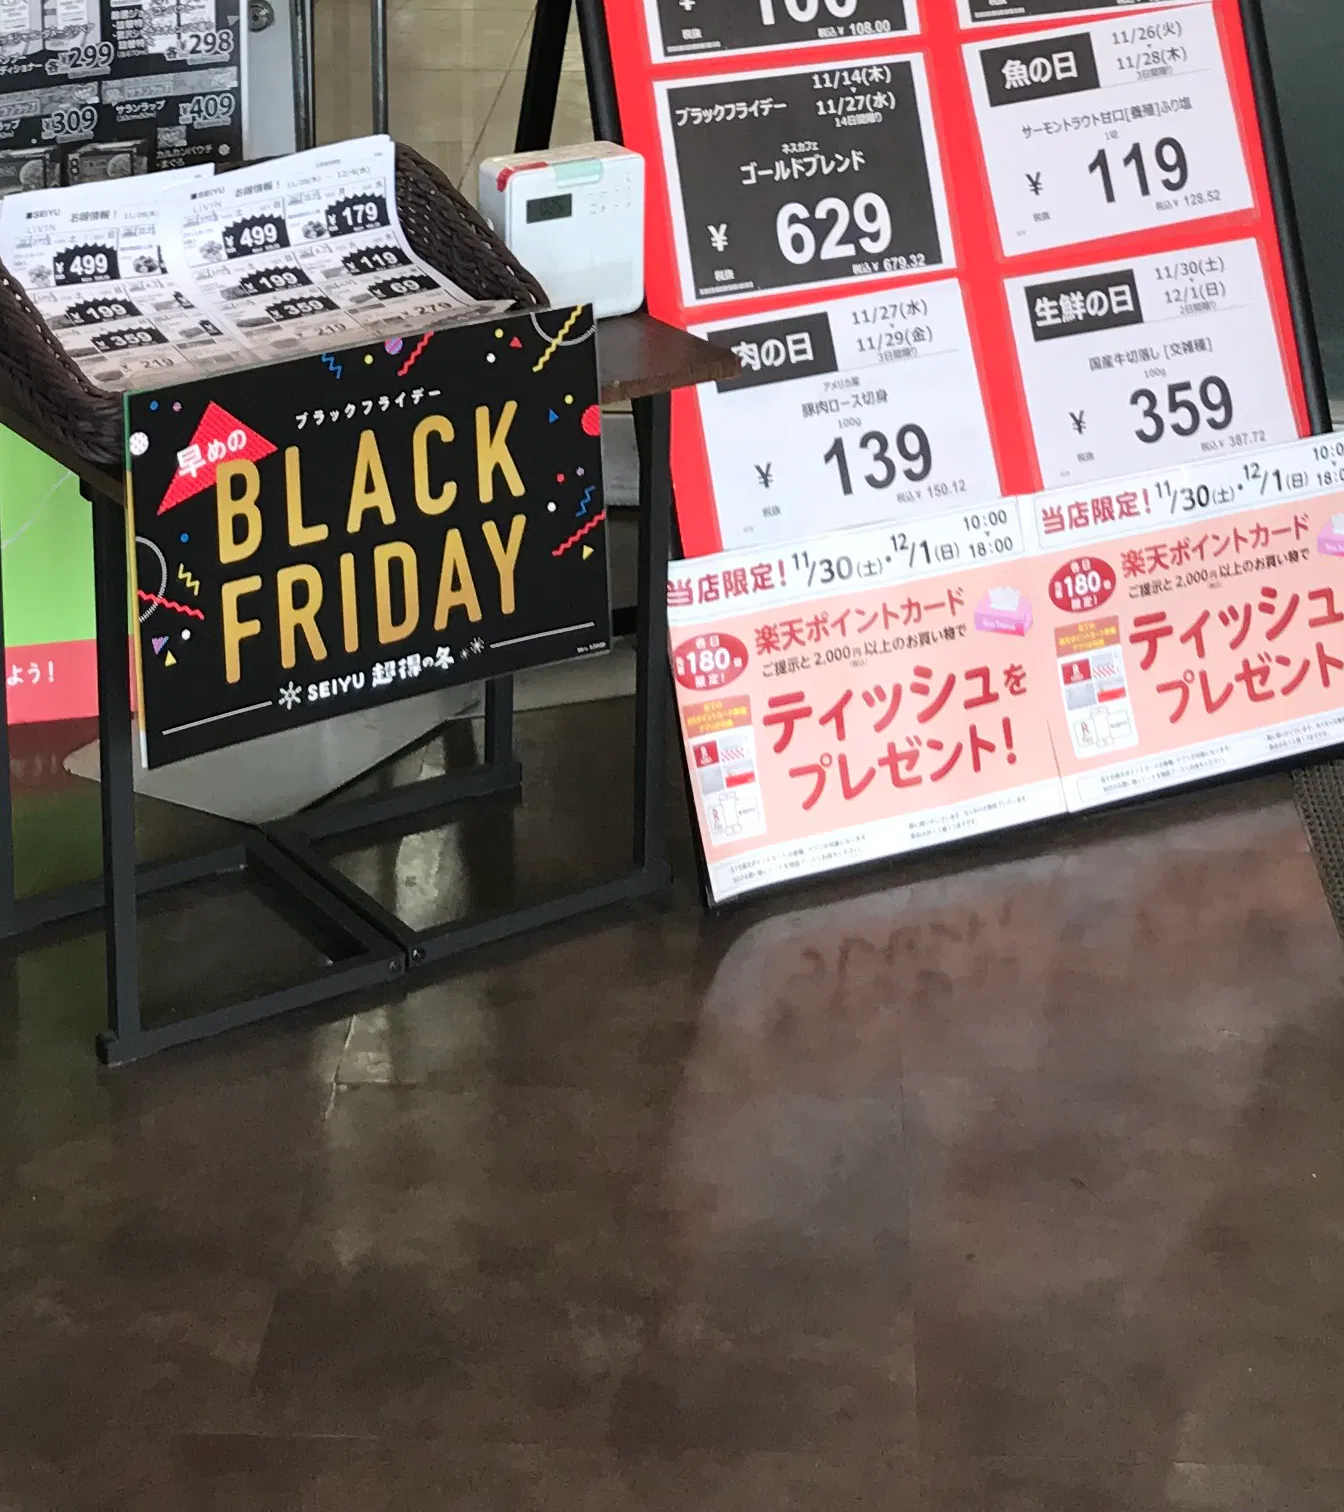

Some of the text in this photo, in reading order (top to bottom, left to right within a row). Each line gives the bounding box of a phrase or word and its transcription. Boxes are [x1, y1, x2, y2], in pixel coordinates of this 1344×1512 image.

[1111, 20, 1182, 45] 11/26(火)
[1001, 50, 1079, 90] 魚の日
[1116, 46, 1188, 70] 11/28(木)
[812, 66, 892, 89] 11/14(木)
[675, 98, 787, 126] ブラックフライデー
[816, 91, 895, 115] 11/27(水)
[781, 140, 819, 154] ネスカフェ
[740, 149, 865, 186] ゴールドブレンド
[1088, 136, 1188, 204] 119
[1184, 189, 1221, 207] 128.52
[343, 202, 379, 227] 179
[239, 223, 278, 247] 499
[776, 192, 892, 265] 629
[68, 256, 108, 274] 499
[360, 251, 398, 269] 119
[1155, 257, 1225, 281] 11/30(土)
[259, 272, 299, 289] 199
[1164, 280, 1226, 304] 12/1(日)
[89, 302, 127, 319] 199
[287, 300, 325, 316] 359
[851, 298, 928, 325] 11/27(水)
[1034, 284, 1135, 327] 生鮮の日
[111, 330, 154, 347] 359
[730, 332, 814, 371] 肉の日
[857, 325, 934, 352] 11/29(金)
[295, 388, 441, 430] ブラックフライデー
[801, 389, 888, 417] 豚肉ロース切身
[1130, 375, 1233, 444] 359
[1228, 430, 1266, 447] 387.72
[176, 429, 248, 479] 早めの
[823, 423, 932, 496] 139
[216, 401, 526, 565] BLACK
[927, 480, 967, 498] 150.12
[962, 510, 1008, 532] 10:00
[1041, 488, 1150, 535] 当店限定!
[968, 536, 1014, 559] 18:00
[1120, 514, 1310, 581] 楽天ポイントカード
[666, 560, 786, 607] 当店限定!
[1064, 572, 1101, 596] 180
[220, 514, 527, 684] FRIDAY
[755, 587, 965, 655] 楽天ポイントカード
[685, 647, 730, 674] 180
[306, 672, 366, 704] SEIYU
[762, 663, 1028, 754] ティッシュを
[789, 717, 1017, 812] プレゼント!
